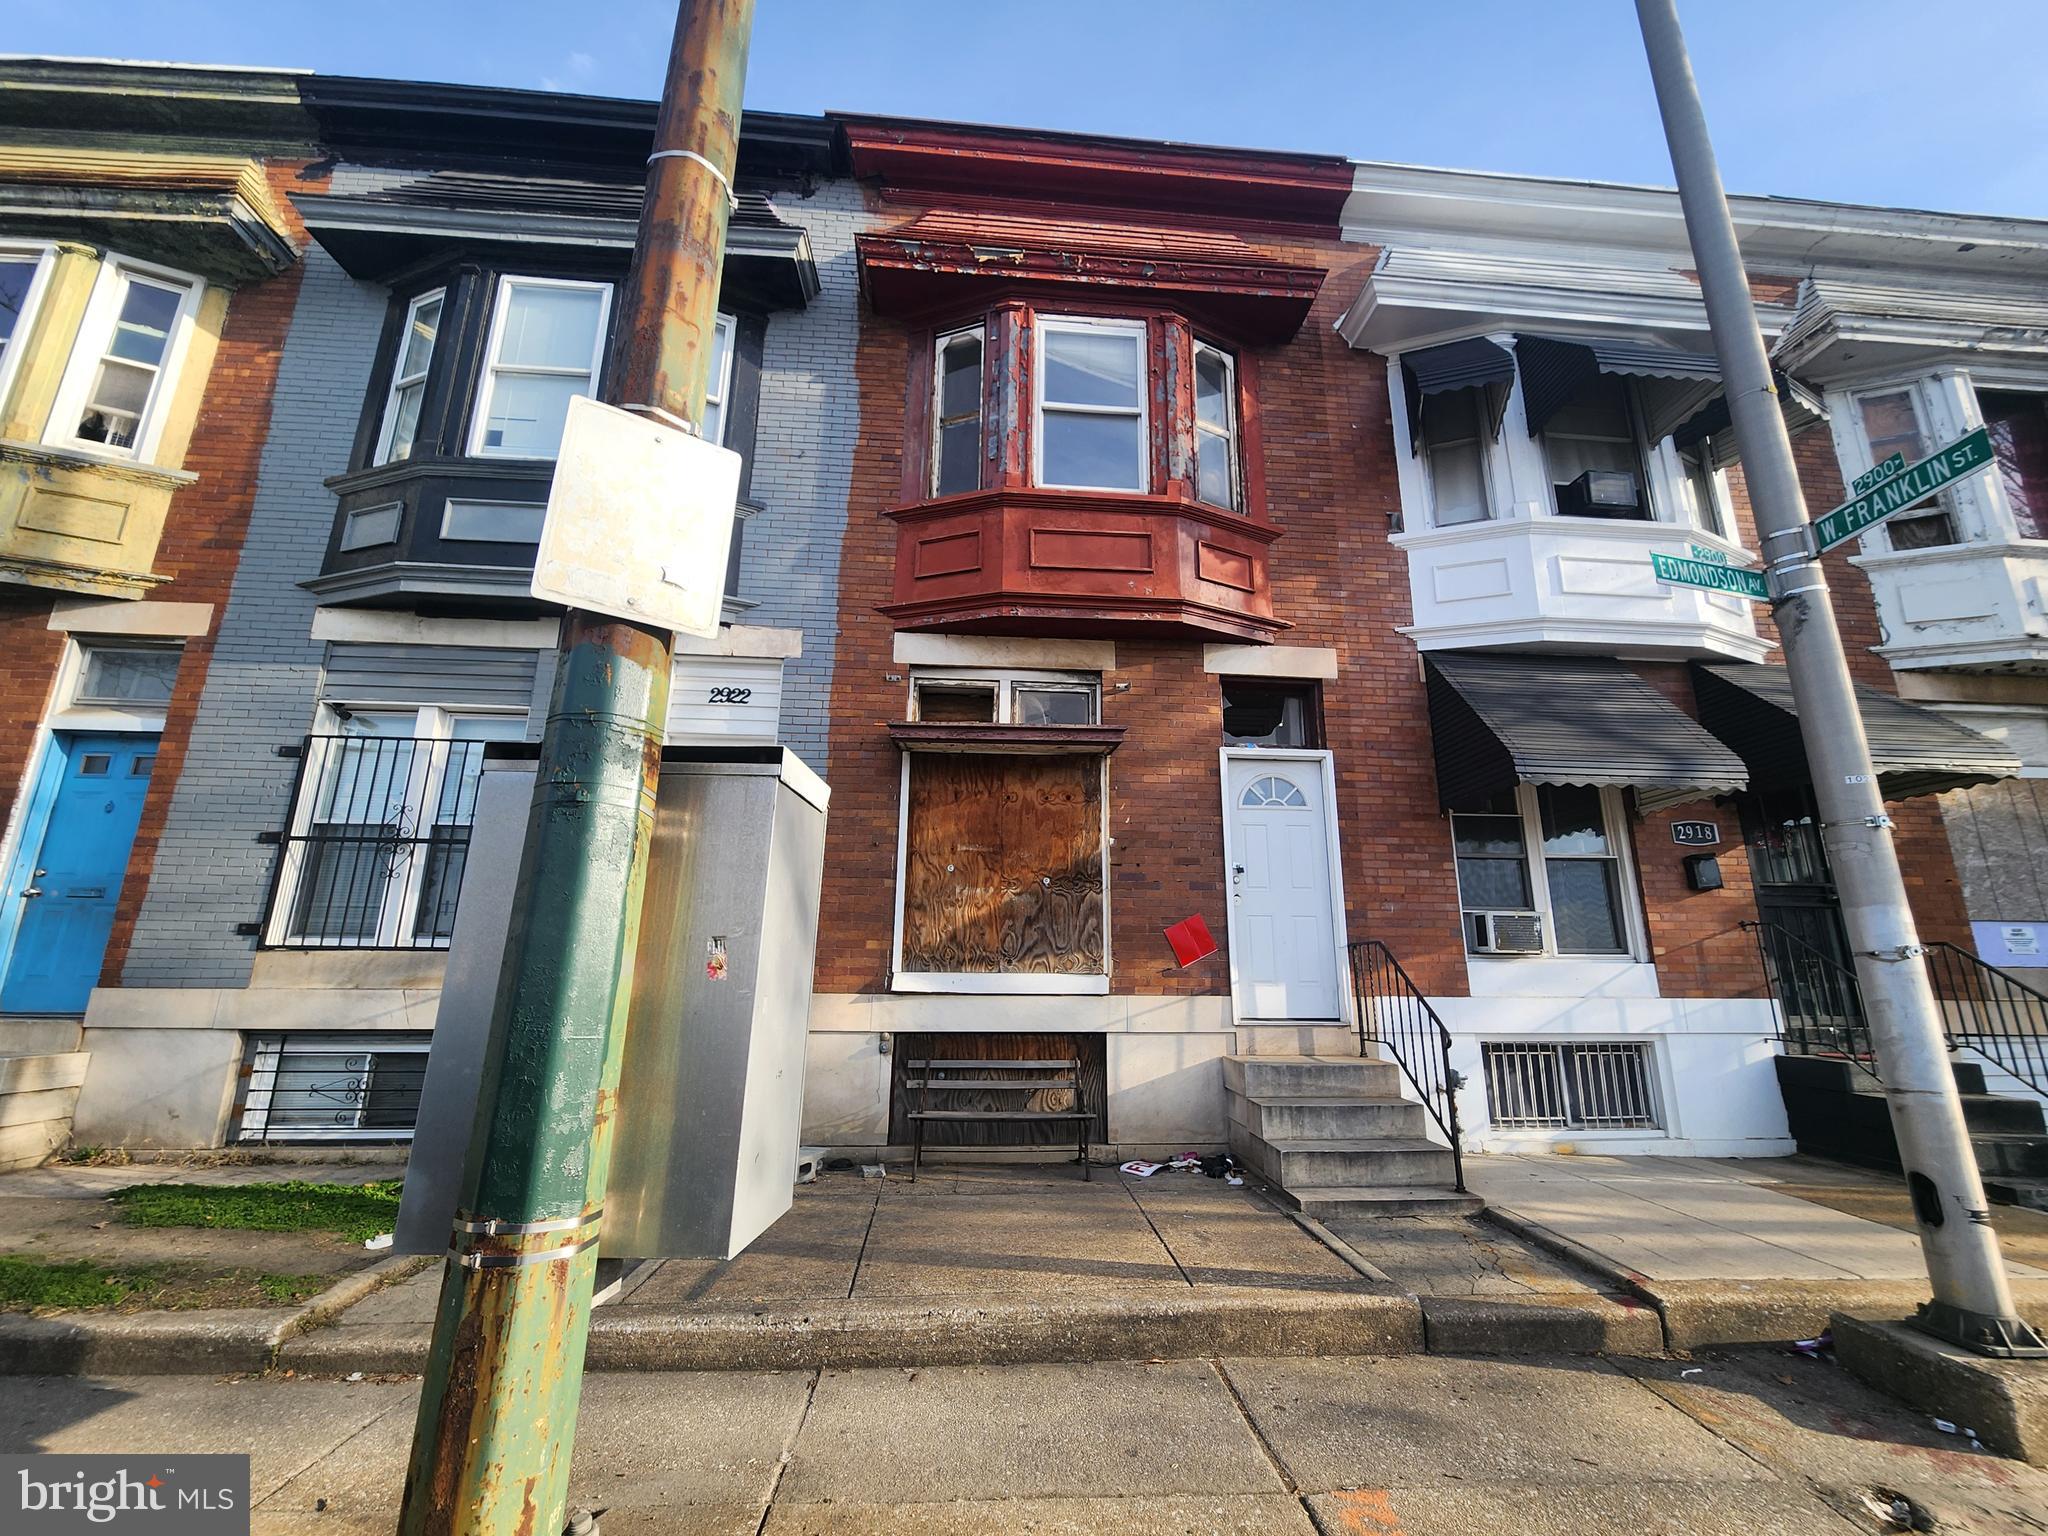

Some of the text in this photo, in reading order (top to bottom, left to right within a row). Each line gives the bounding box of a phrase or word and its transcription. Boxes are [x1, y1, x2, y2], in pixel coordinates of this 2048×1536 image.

[1854, 459, 1895, 494] 2900
[1821, 444, 1978, 542] W. FRANKLIN ST.
[1699, 548, 1725, 564] 2900
[1658, 557, 1764, 593] EDMONDSON AV.
[708, 687, 751, 704] 2922
[1677, 825, 1712, 840] 2918
